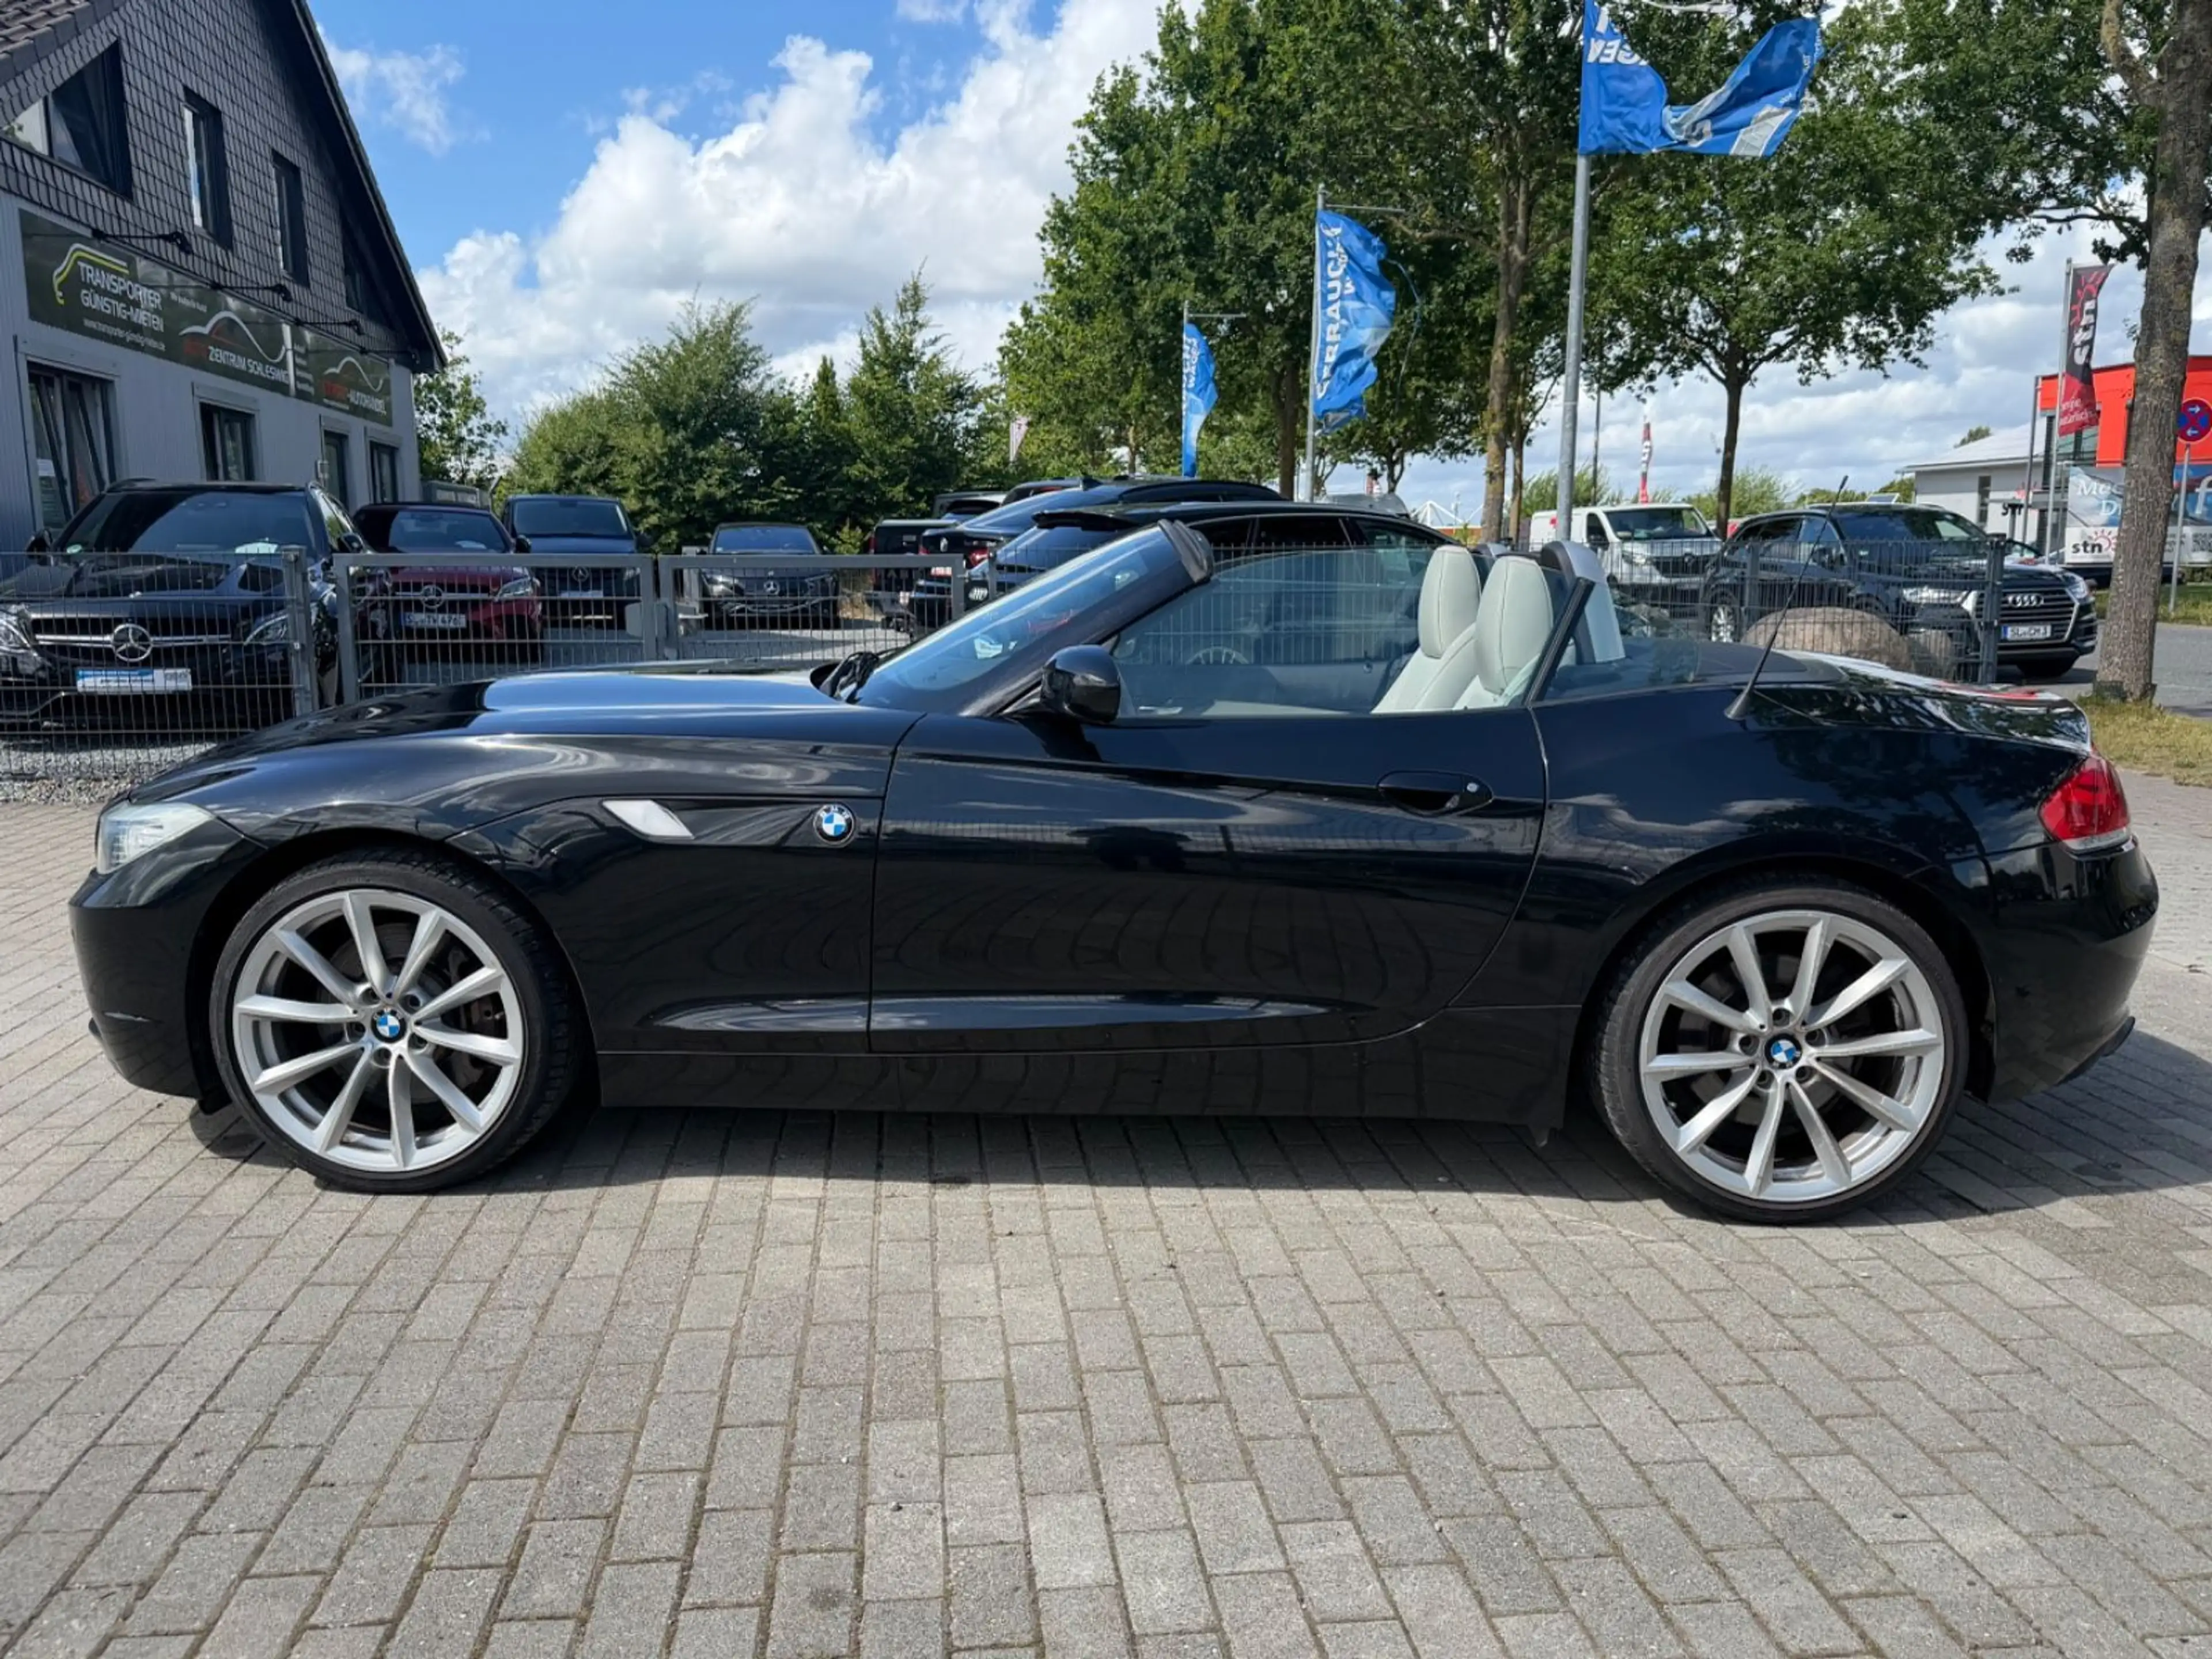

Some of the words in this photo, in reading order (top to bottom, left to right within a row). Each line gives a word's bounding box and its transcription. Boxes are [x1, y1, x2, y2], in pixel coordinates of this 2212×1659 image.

[77, 261, 162, 311] TRANSPORTER
[207, 345, 247, 372] ZENTRUM
[2072, 540, 2103, 554] stn
